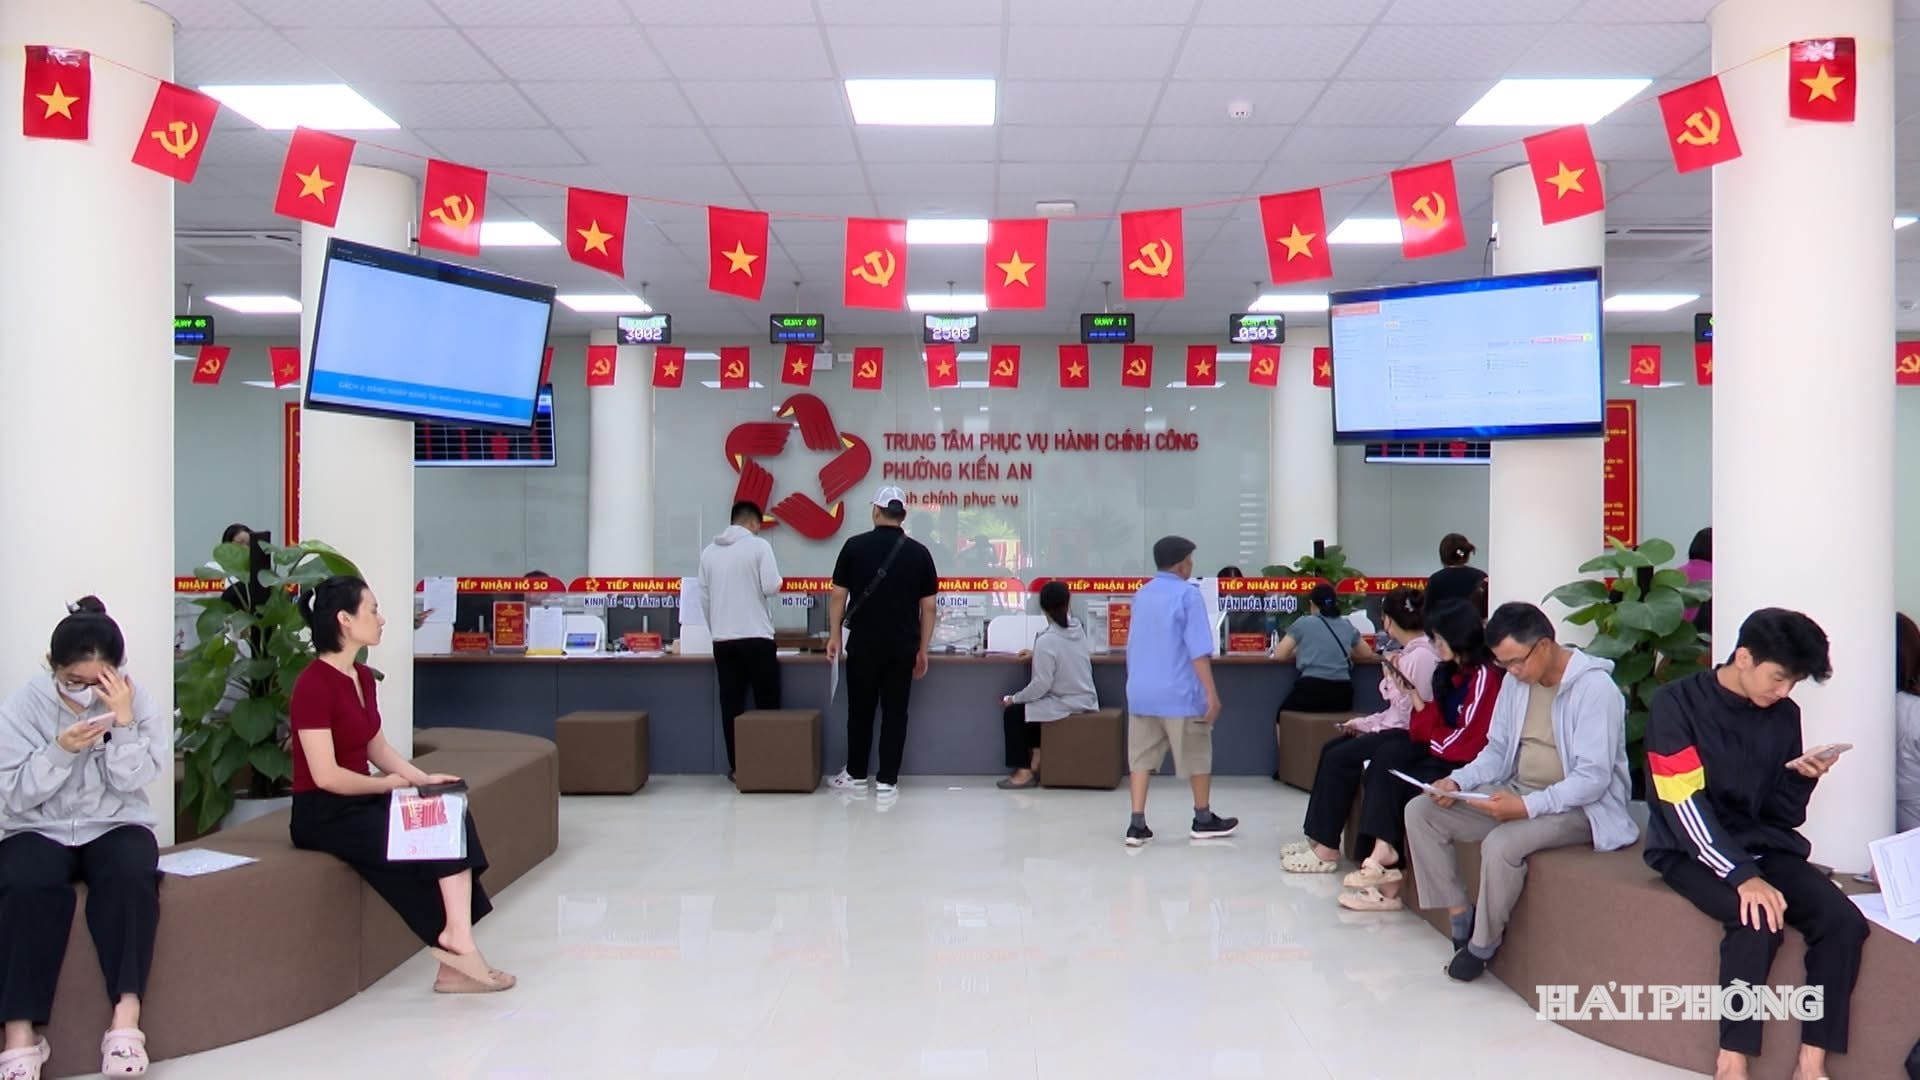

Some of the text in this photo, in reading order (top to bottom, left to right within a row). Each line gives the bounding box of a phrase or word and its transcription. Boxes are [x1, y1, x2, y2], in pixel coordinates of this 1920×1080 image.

[625, 328, 662, 341] 3002
[932, 328, 970, 340] 2508
[1239, 327, 1277, 340] 0503
[883, 428, 1199, 454] TRUNG TÂM PHỤC VỤ HÀNH CHÍNH CÔNG
[883, 454, 1033, 481] PHƯỜNG KIẾN AN
[922, 490, 958, 505] chính
[963, 491, 996, 511] phục
[1002, 494, 1019, 508] vụ
[178, 579, 209, 592] NHẬN
[481, 580, 512, 592] NHẬN
[606, 579, 630, 590] TIẾP
[632, 580, 664, 592] NHẬN
[786, 579, 818, 592] NHẬN
[938, 579, 970, 592] NHẬN
[1066, 579, 1091, 590] TIẾP
[1093, 580, 1125, 592] NHẬN
[1220, 579, 1244, 590] TIẾP
[1246, 580, 1279, 592] NHẬN
[1375, 579, 1399, 590] TIẾP
[584, 596, 605, 608] KINH
[1219, 594, 1240, 611] VĂN
[1263, 595, 1279, 611] XÃ
[1280, 595, 1298, 613] HỘI
